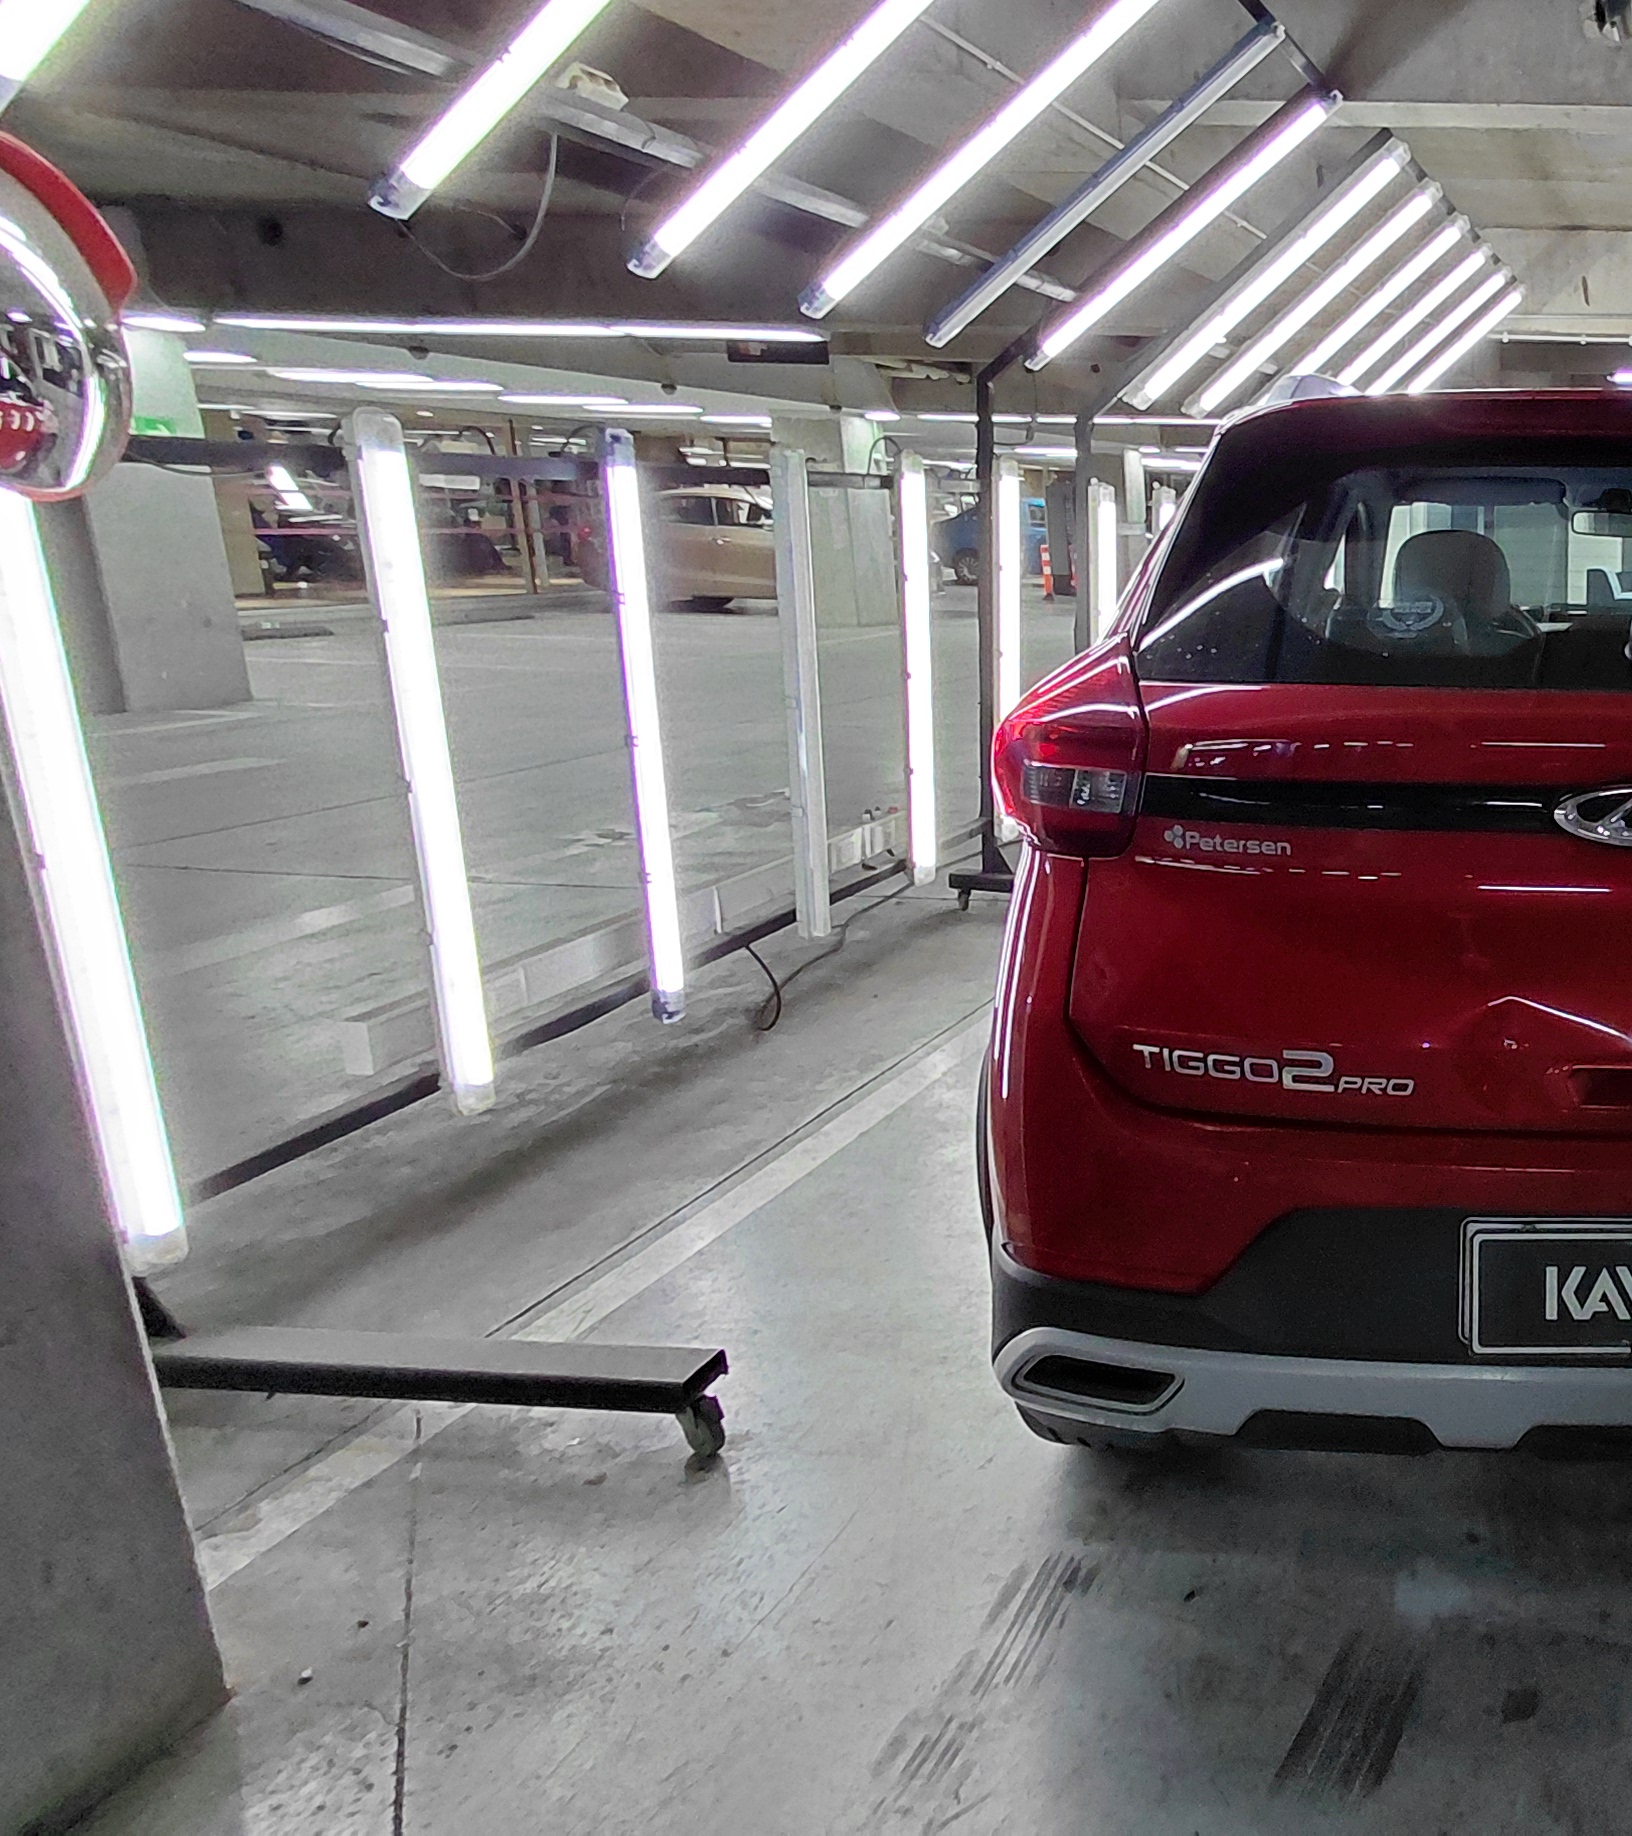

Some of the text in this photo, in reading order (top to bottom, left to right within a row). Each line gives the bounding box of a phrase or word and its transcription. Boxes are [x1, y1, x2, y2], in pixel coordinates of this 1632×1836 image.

[1185, 831, 1291, 856] Petersen
[1132, 1044, 1280, 1083] TIGGO
[1337, 1076, 1415, 1096] PRO
